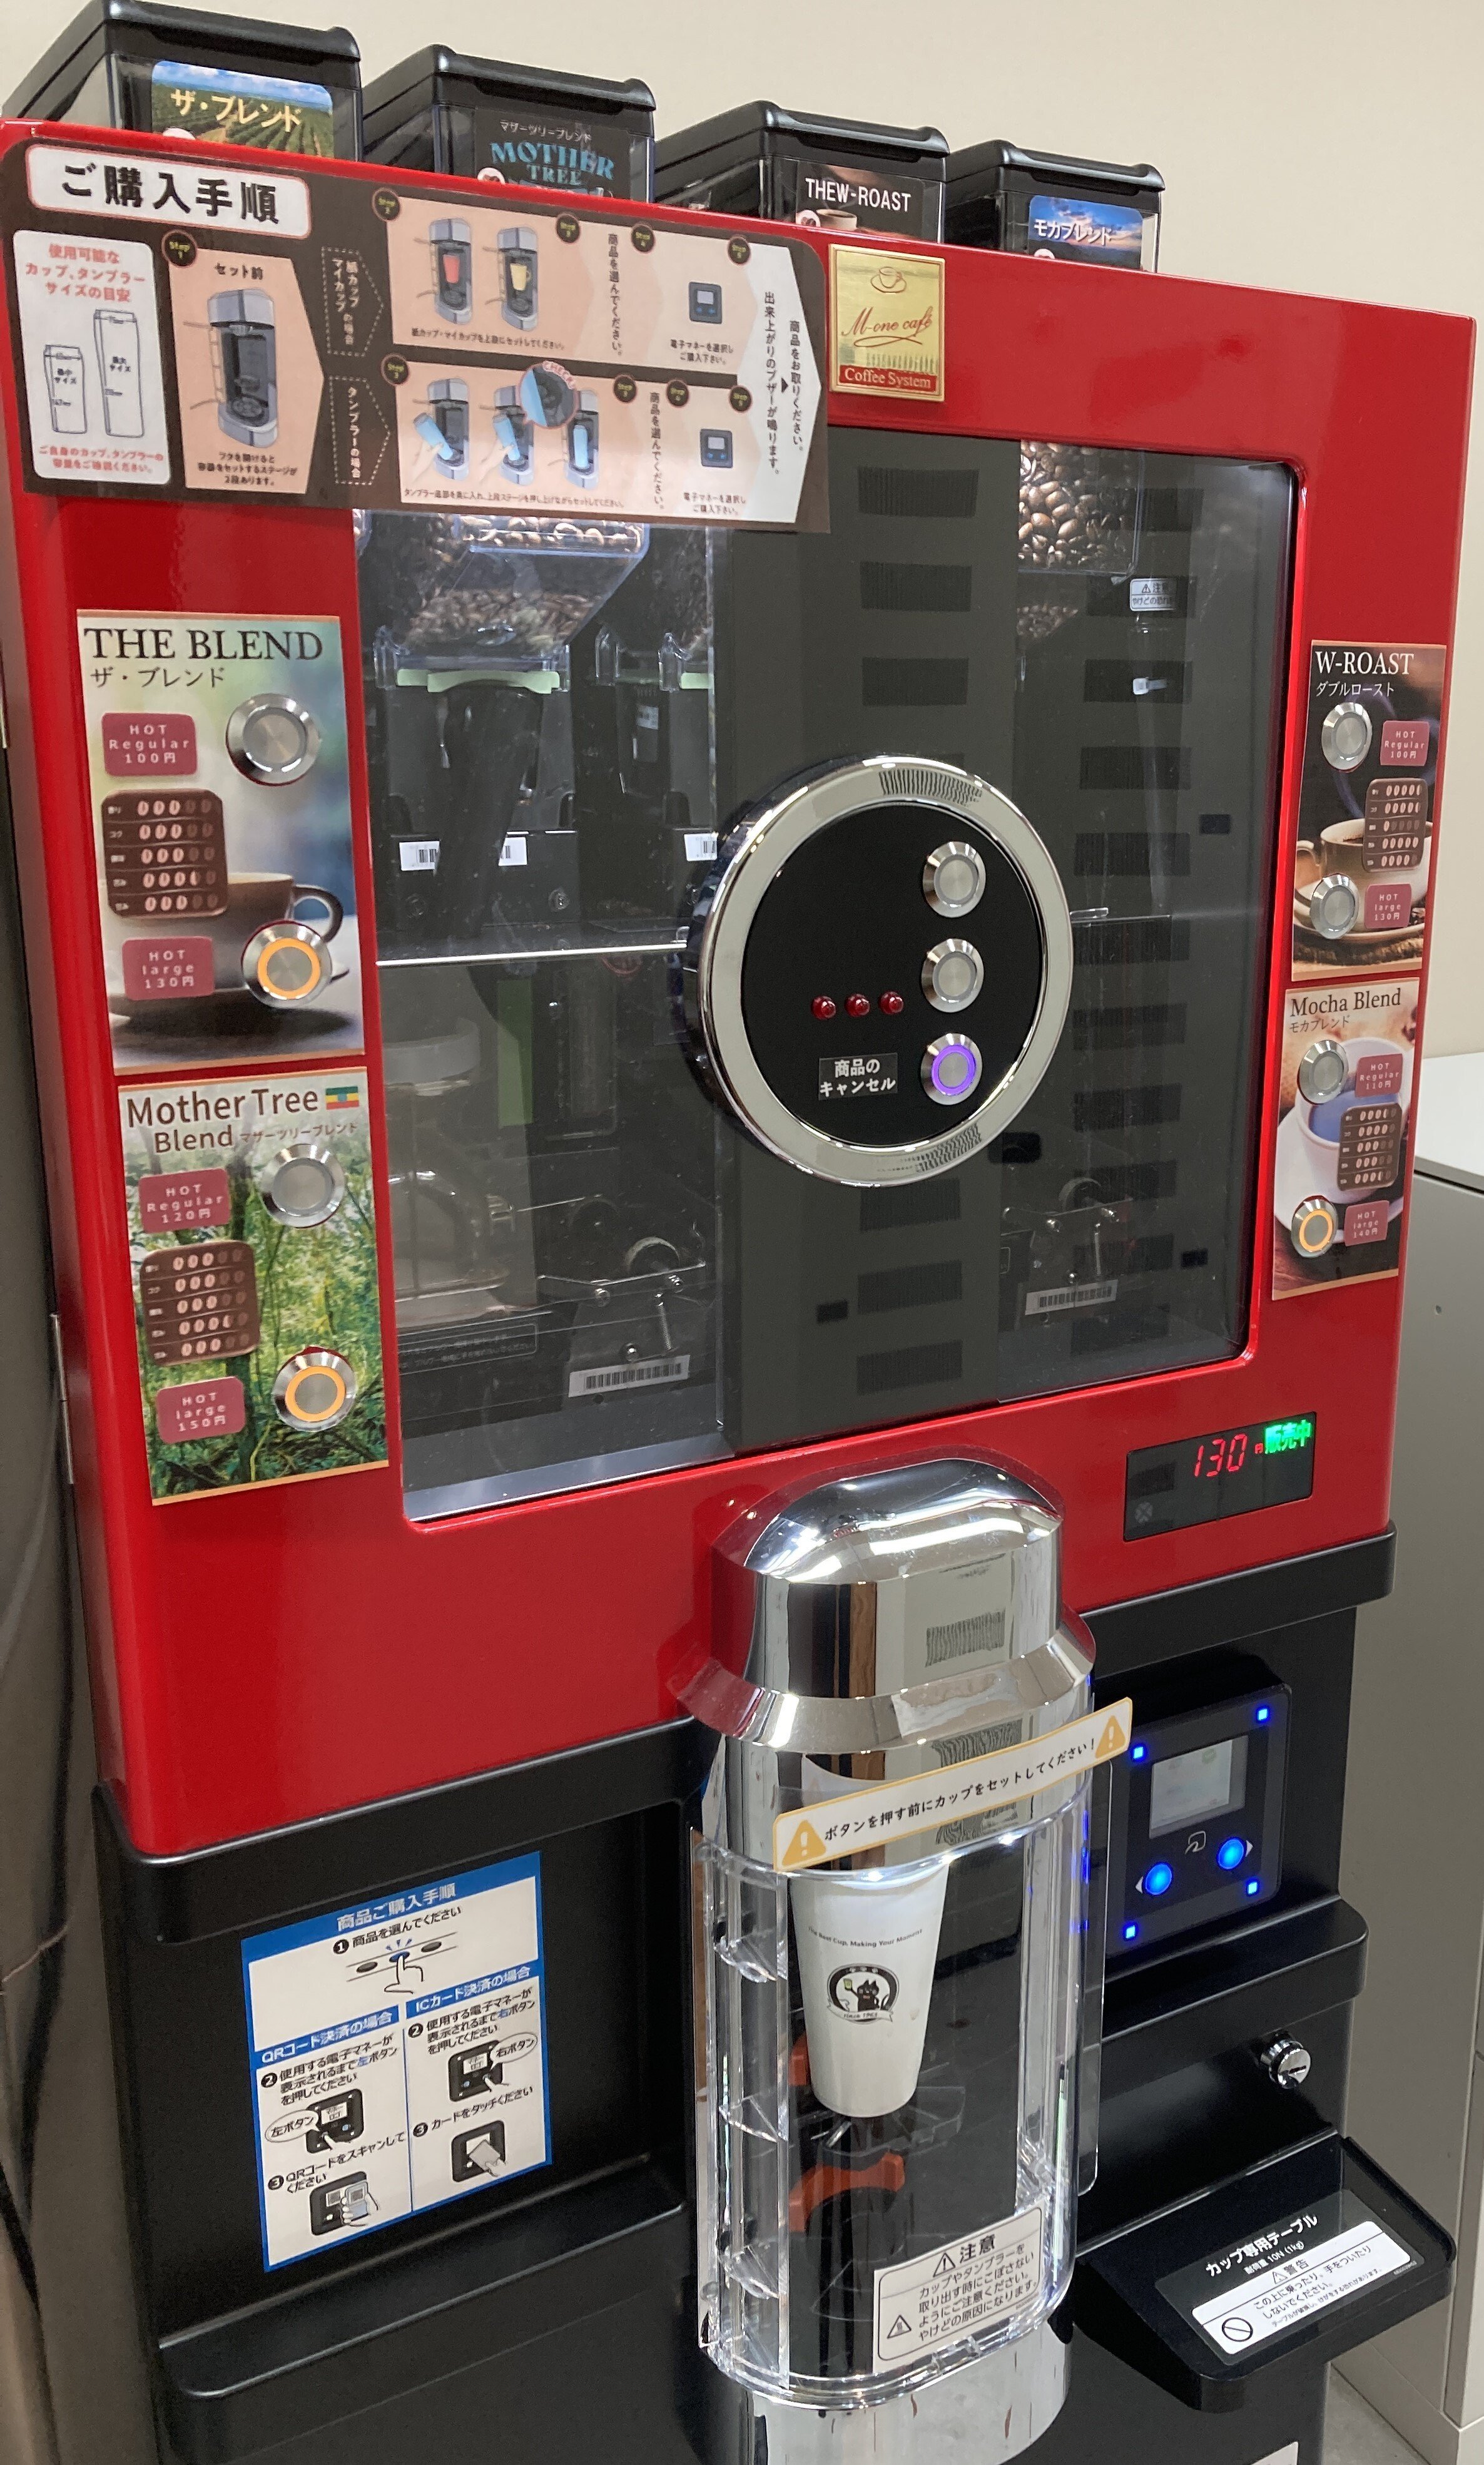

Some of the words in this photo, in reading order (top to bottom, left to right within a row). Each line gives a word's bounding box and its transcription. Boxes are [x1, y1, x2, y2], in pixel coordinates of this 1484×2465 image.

[171, 88, 301, 132] ザ・ブレンド
[490, 141, 615, 180] MOTHER
[527, 164, 581, 185] TREE
[62, 161, 280, 225] ご購入手順
[1034, 219, 1112, 245] モカブレンド
[49, 243, 119, 263] 使用可能な
[215, 263, 263, 280] セット前
[46, 282, 130, 302] サイズの目安
[845, 368, 885, 384] Coffee
[888, 372, 931, 389] System
[347, 386, 361, 479] タンブラーの場合
[84, 628, 176, 659] THE
[186, 629, 323, 660] BLEND
[1314, 651, 1415, 675] W-ROAST
[90, 667, 226, 688] ザ・ブレンド
[1316, 681, 1395, 697] ダブルロースト
[130, 724, 168, 735] HOT
[109, 738, 190, 753] Regular
[1384, 740, 1425, 750] Regular
[1390, 751, 1417, 759] 100円
[125, 753, 176, 765] 100円
[1380, 893, 1398, 901] HOT
[1375, 904, 1401, 912] large
[1375, 912, 1400, 921] 130円
[149, 949, 186, 962] HOT
[142, 963, 195, 977] large
[145, 976, 195, 989] 130円
[1290, 994, 1348, 1018] Mocha
[1353, 988, 1401, 1010] Blend
[1289, 1015, 1350, 1033] モカブレンド
[834, 1058, 881, 1078] 商品の
[1359, 1071, 1400, 1081] Regular
[1371, 1063, 1389, 1071] HOT
[820, 1078, 896, 1098] キャンセル
[127, 1090, 246, 1128] Mother
[251, 1088, 318, 1116] Tree
[154, 1124, 233, 1154] Blend
[240, 1123, 358, 1143] マザーツリーブレンド
[165, 1183, 202, 1197] HOT
[146, 1195, 224, 1213] Regular
[161, 1208, 211, 1224] 120円
[1353, 1220, 1379, 1230] large
[1358, 1211, 1376, 1220] HOT
[181, 1392, 218, 1406] HOT
[176, 1404, 226, 1419] large
[178, 1416, 226, 1432] 150円
[1194, 1434, 1247, 1477] 130
[1264, 1419, 1311, 1454] 販売中
[336, 1882, 457, 1931] 商品ご購入手順
[352, 1905, 462, 1947] 商品を選んでください
[416, 1967, 531, 2013] ICカード決済の場合
[426, 1987, 534, 2031] 使用する電子マネーが
[427, 1999, 536, 2044] 表示されるまで右ボタン
[262, 2011, 394, 2063] QRコード決済の場合
[429, 2024, 498, 2055] を押してください
[496, 2038, 535, 2058] 右ボタン
[280, 2036, 393, 2082] 使用する電子マネーが
[280, 2047, 398, 2094] 表示されるまで左ボタン
[282, 2073, 358, 2106] を押してください
[432, 2086, 534, 2130] カードをタッチください
[270, 2116, 315, 2137] 左ボタン
[286, 2130, 406, 2182] QRコードをスキャンして
[287, 2173, 327, 2193] ください
[960, 2234, 995, 2263] 注意
[1206, 2215, 1318, 2277] カップ専用テーブル
[1268, 2250, 1285, 2262] 10N
[920, 2243, 1025, 2299] カップやタンブラーを
[1284, 2258, 1309, 2275] 警告
[919, 2252, 1034, 2312] 取り出す時にこぼさない
[919, 2272, 1029, 2328] ようにご注意ください。
[1263, 2281, 1333, 2319] しないでください。
[919, 2281, 1037, 2341] やけどの原因になります。
